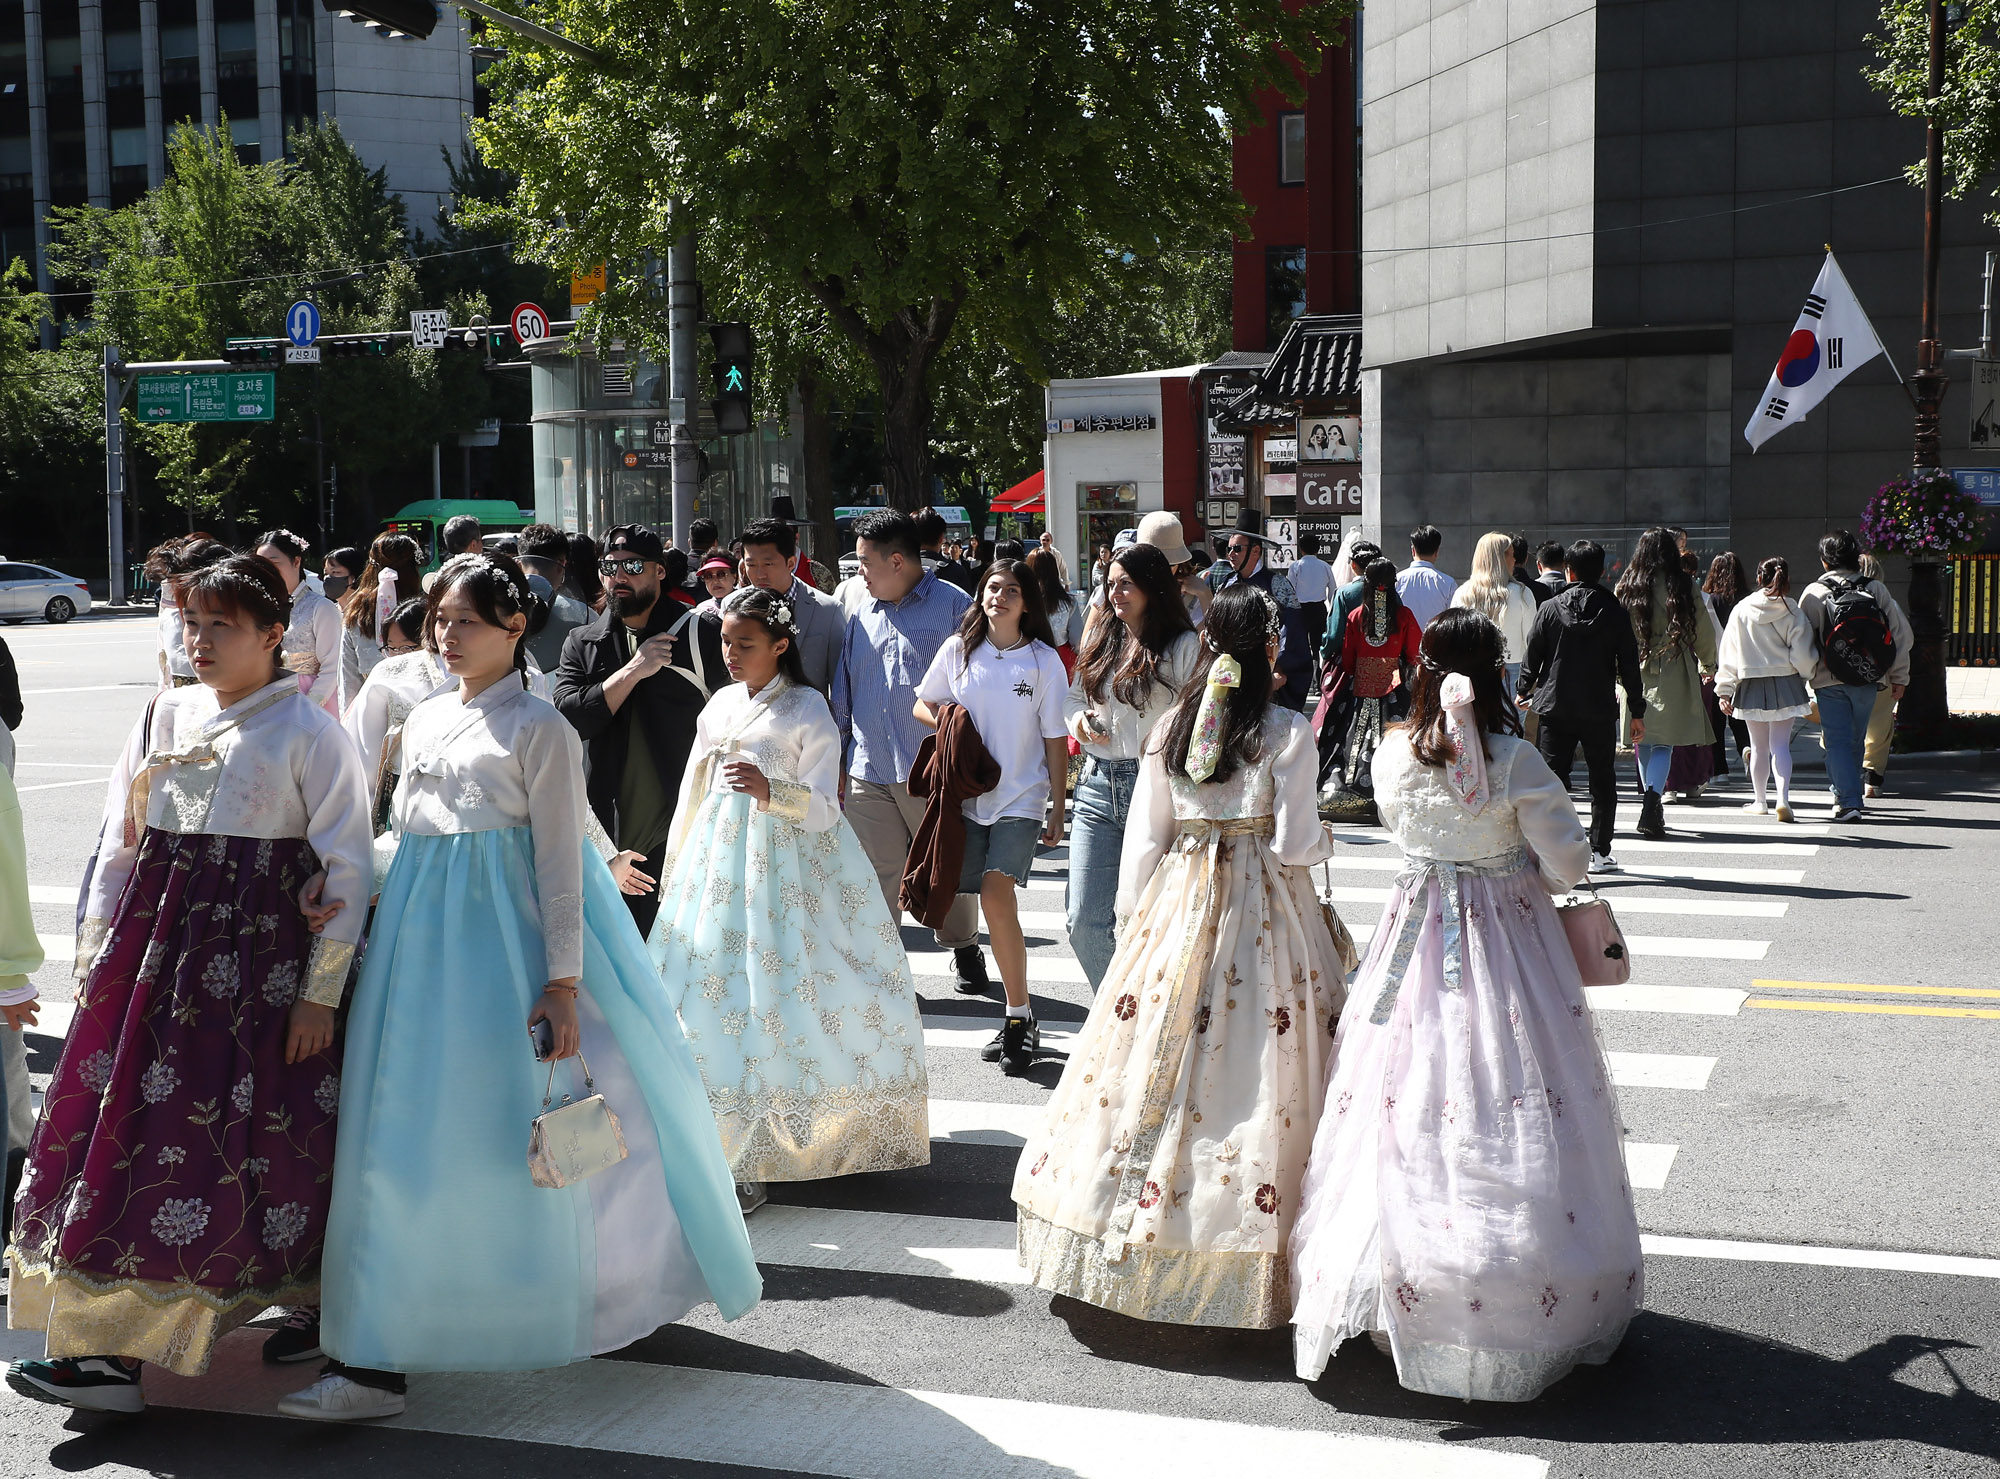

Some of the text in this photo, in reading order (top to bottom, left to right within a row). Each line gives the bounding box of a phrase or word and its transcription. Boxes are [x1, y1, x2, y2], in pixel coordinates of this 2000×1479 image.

[413, 313, 447, 345] 신호준수
[519, 315, 542, 339] 50
[295, 350, 318, 360] 신호시
[192, 377, 218, 389] 수색역
[1980, 368, 2000, 384] 견인지
[236, 379, 264, 392] 효자동
[1077, 414, 1150, 433] 세종편의점
[1209, 444, 1217, 455] 3
[1963, 475, 2000, 489] 통의
[1303, 479, 1362, 506] Cafe
[1299, 523, 1339, 531] SELF PHOTO
